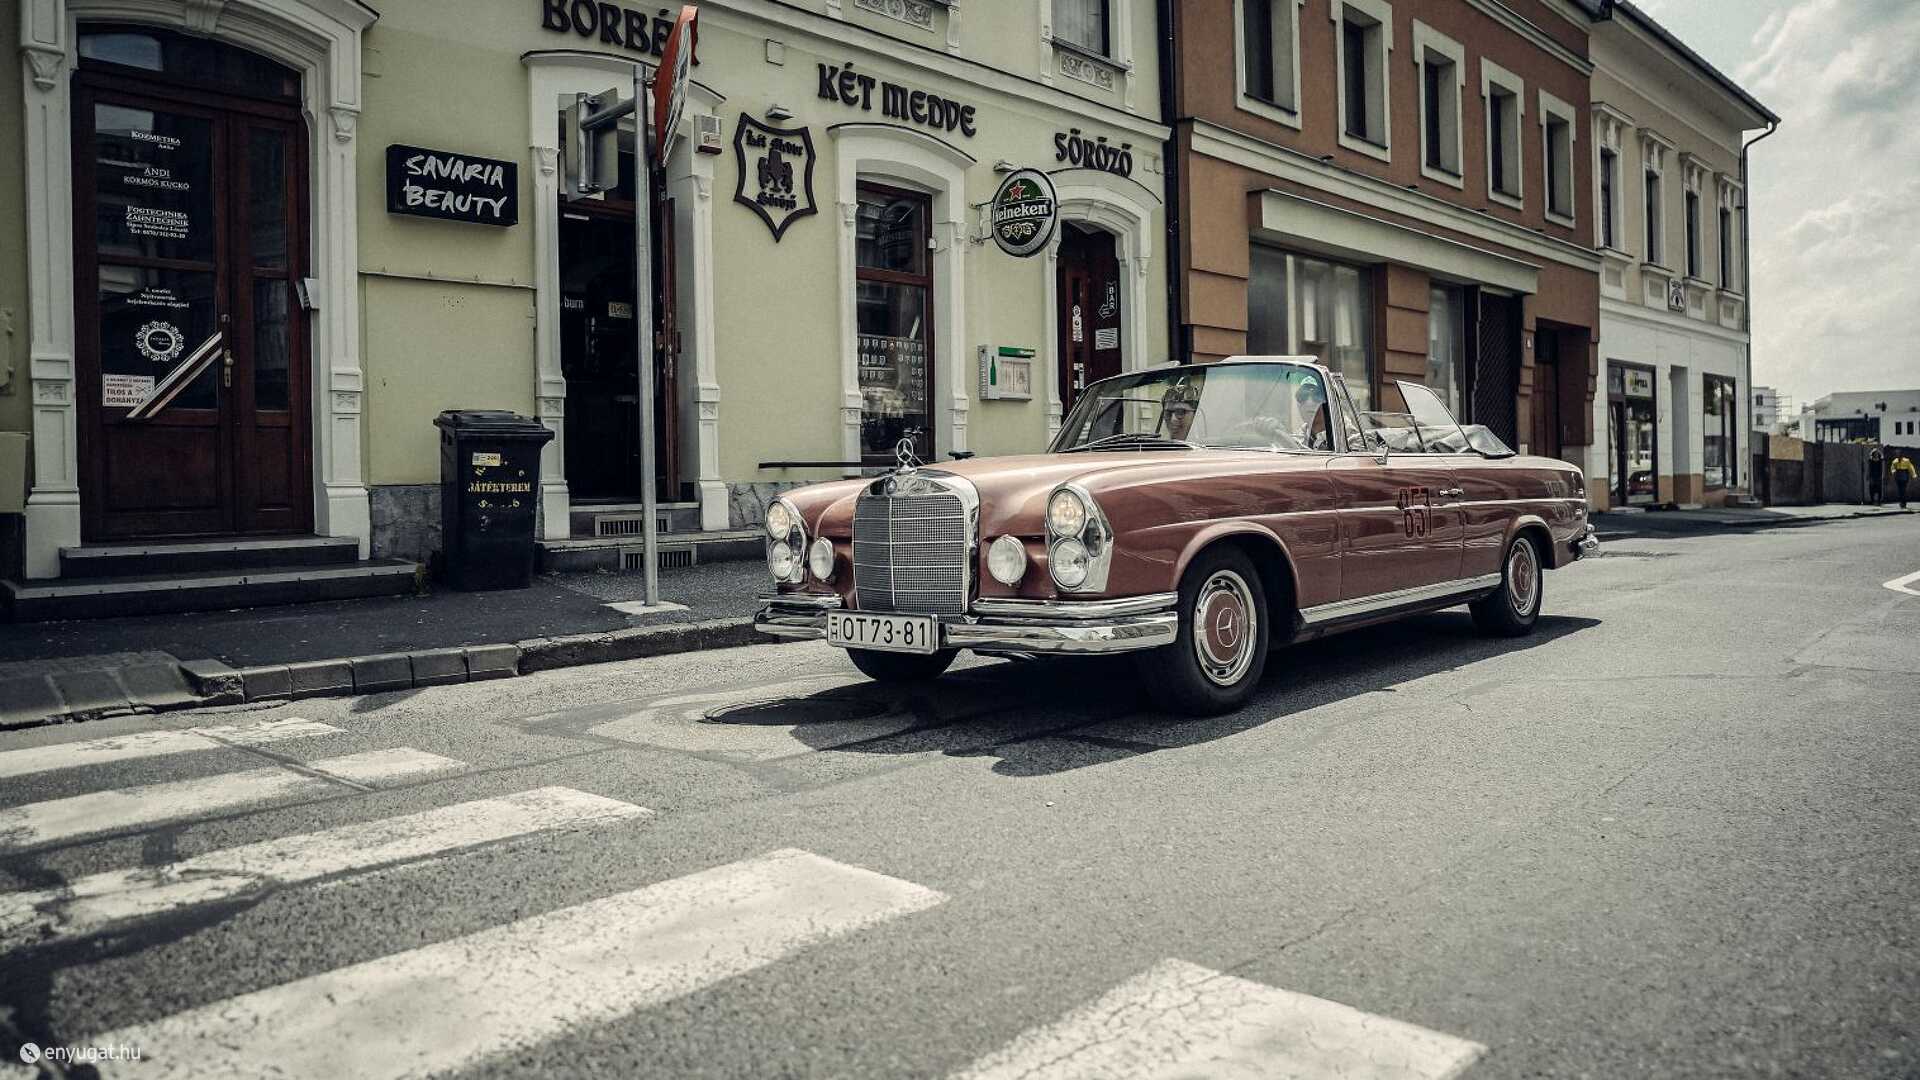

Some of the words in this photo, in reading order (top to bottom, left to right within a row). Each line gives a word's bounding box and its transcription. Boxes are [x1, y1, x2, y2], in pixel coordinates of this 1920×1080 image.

[818, 62, 876, 110] KÉT
[882, 82, 977, 138] MEDVE
[405, 154, 504, 189] SAVARIA
[402, 177, 508, 218] BEAUTY
